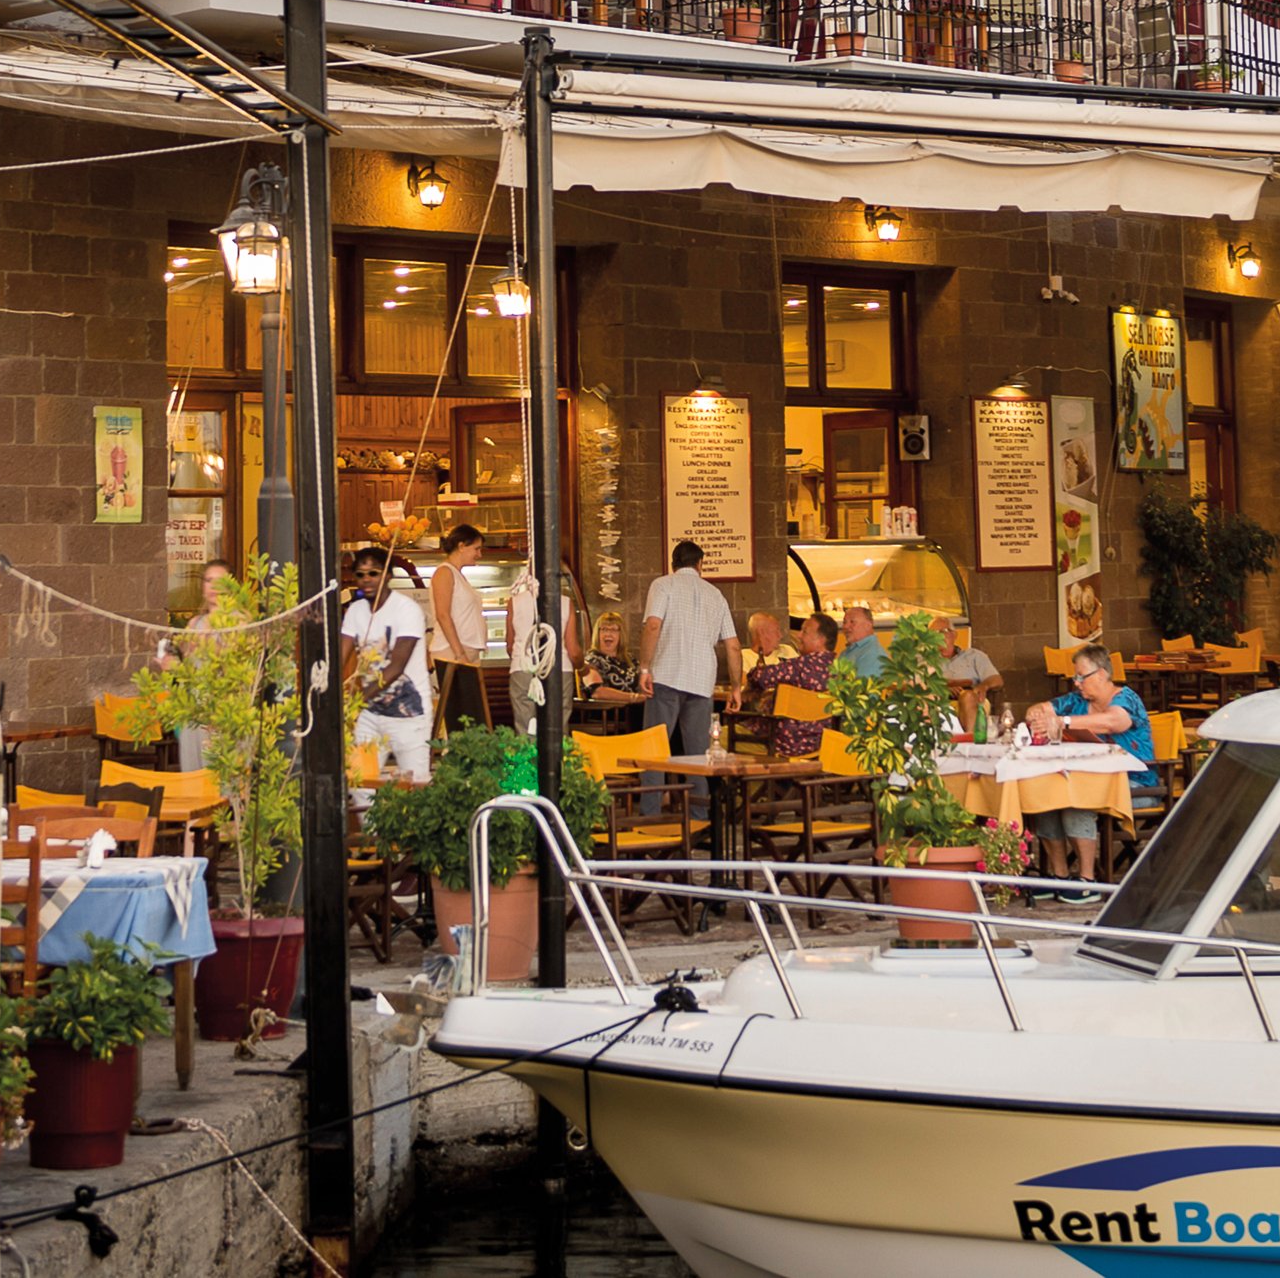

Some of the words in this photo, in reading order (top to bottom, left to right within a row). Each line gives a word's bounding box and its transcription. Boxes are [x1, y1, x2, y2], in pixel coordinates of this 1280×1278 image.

[1128, 323, 1144, 345] SEA
[1147, 324, 1174, 347] HORSE
[166, 519, 207, 531] BSTER
[178, 535, 205, 546] TAKEN
[669, 1037, 689, 1050] TM
[689, 1040, 714, 1053] 553
[1013, 1200, 1161, 1244] Rent
